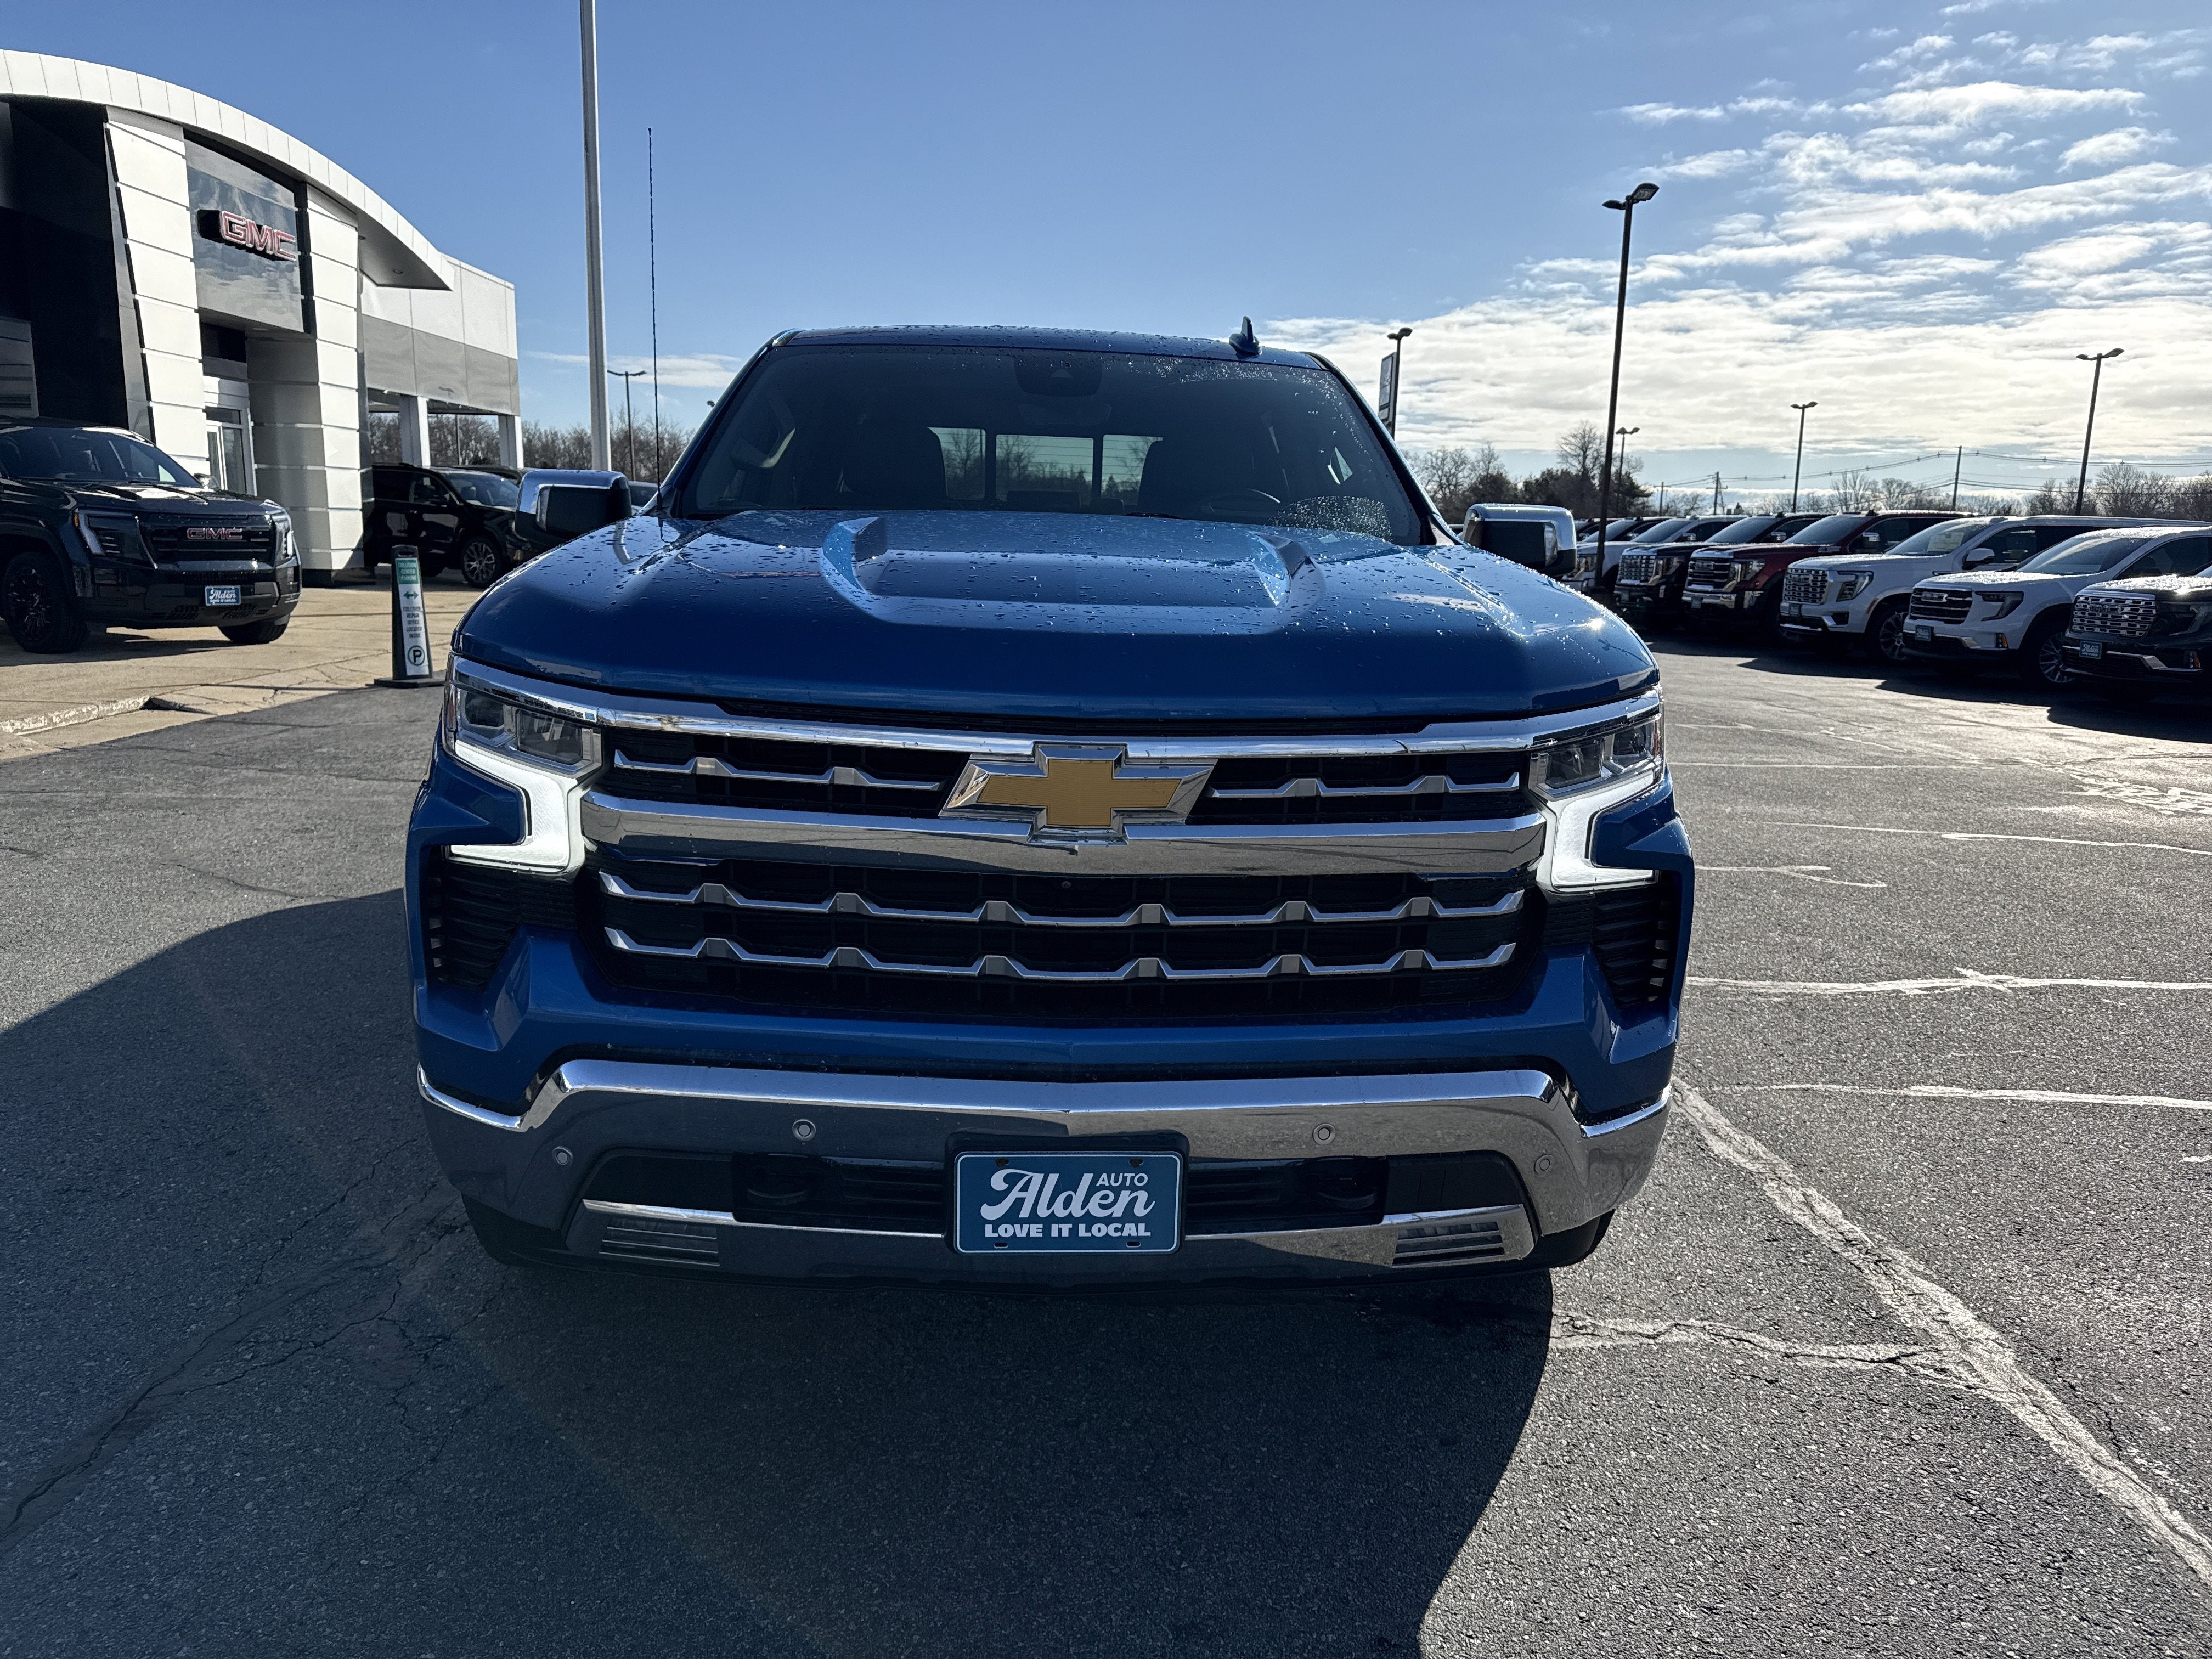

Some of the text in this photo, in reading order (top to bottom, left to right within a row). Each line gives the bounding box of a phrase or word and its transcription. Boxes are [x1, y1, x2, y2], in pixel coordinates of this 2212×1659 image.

[221, 210, 297, 262] GMC
[187, 527, 243, 539] GMC
[209, 589, 236, 599] Alden
[413, 650, 422, 663] P
[1096, 1173, 1148, 1187] AUTO
[980, 1169, 1155, 1220] Alden
[985, 1223, 1151, 1238] LOVE IT LOCAL
